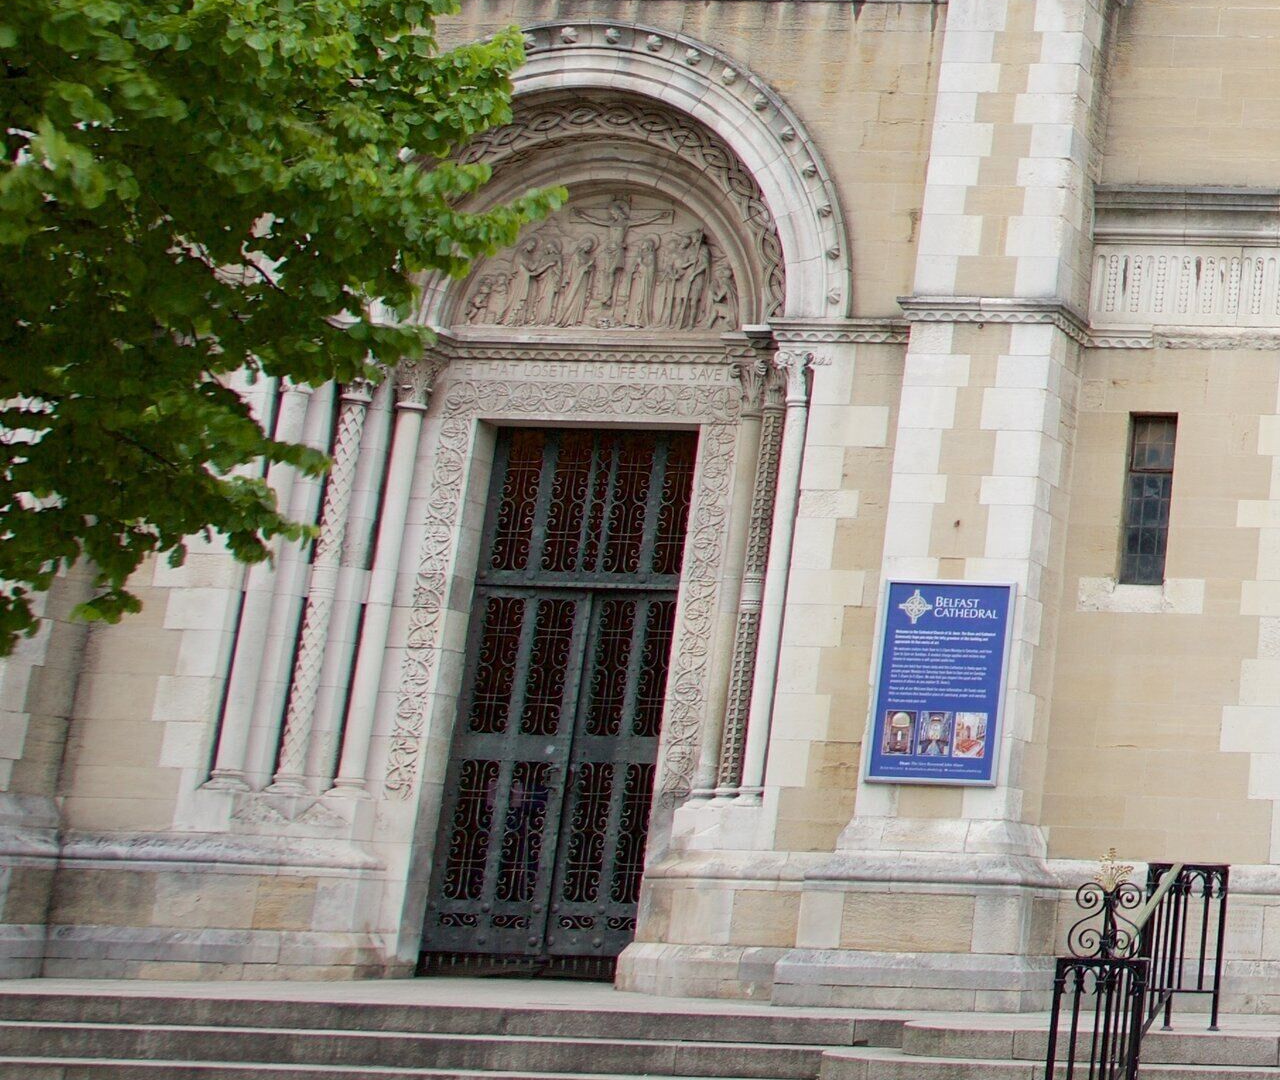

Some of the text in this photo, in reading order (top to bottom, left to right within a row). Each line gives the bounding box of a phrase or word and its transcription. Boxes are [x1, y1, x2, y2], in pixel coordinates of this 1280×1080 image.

[478, 363, 519, 376] THAT
[524, 364, 578, 377] LOSETH
[609, 366, 636, 379] LIFE
[639, 367, 684, 380] SHALL
[689, 367, 722, 381] SAVE
[936, 596, 980, 609] BELFAST
[934, 607, 998, 619] CATHEDRAL
